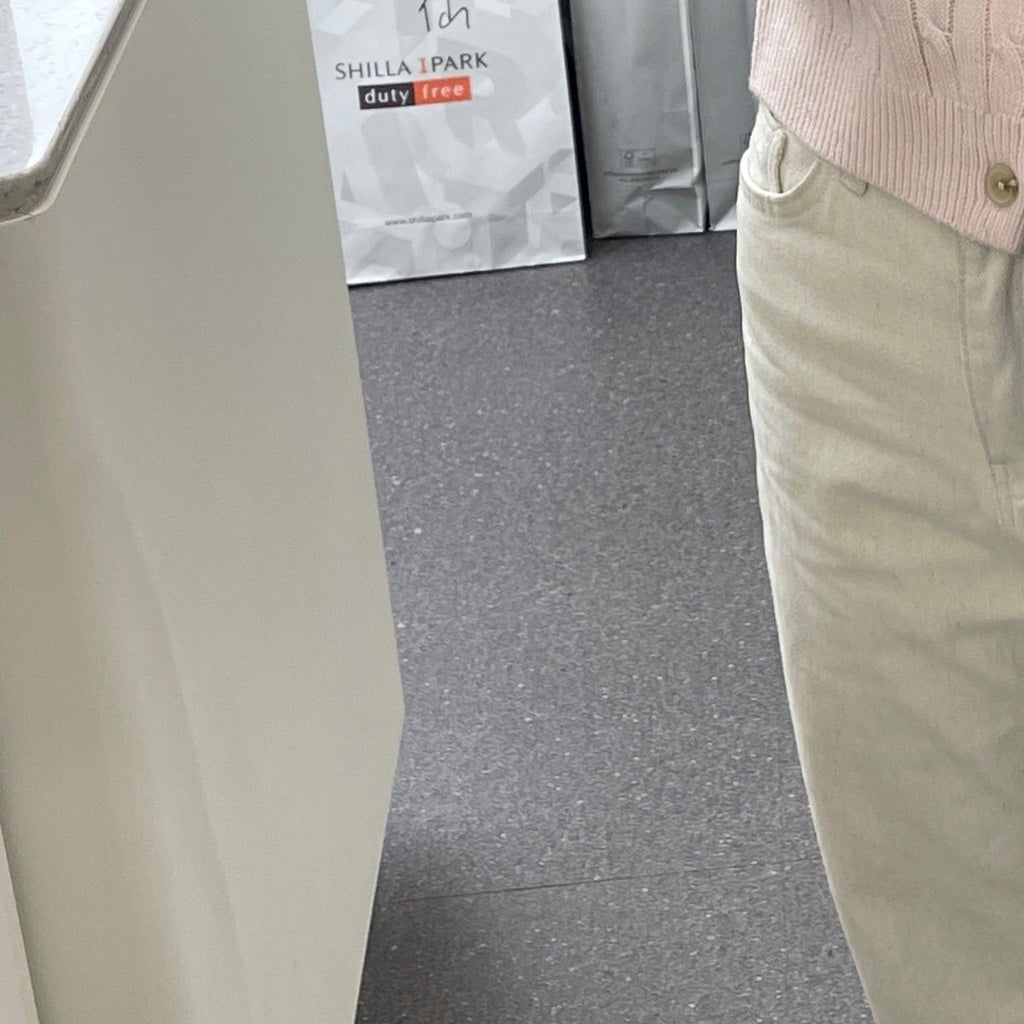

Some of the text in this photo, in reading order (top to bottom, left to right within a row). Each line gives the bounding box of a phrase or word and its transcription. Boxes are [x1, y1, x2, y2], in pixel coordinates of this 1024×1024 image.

[335, 59, 411, 80] SHILLA
[364, 83, 465, 106] duty free
